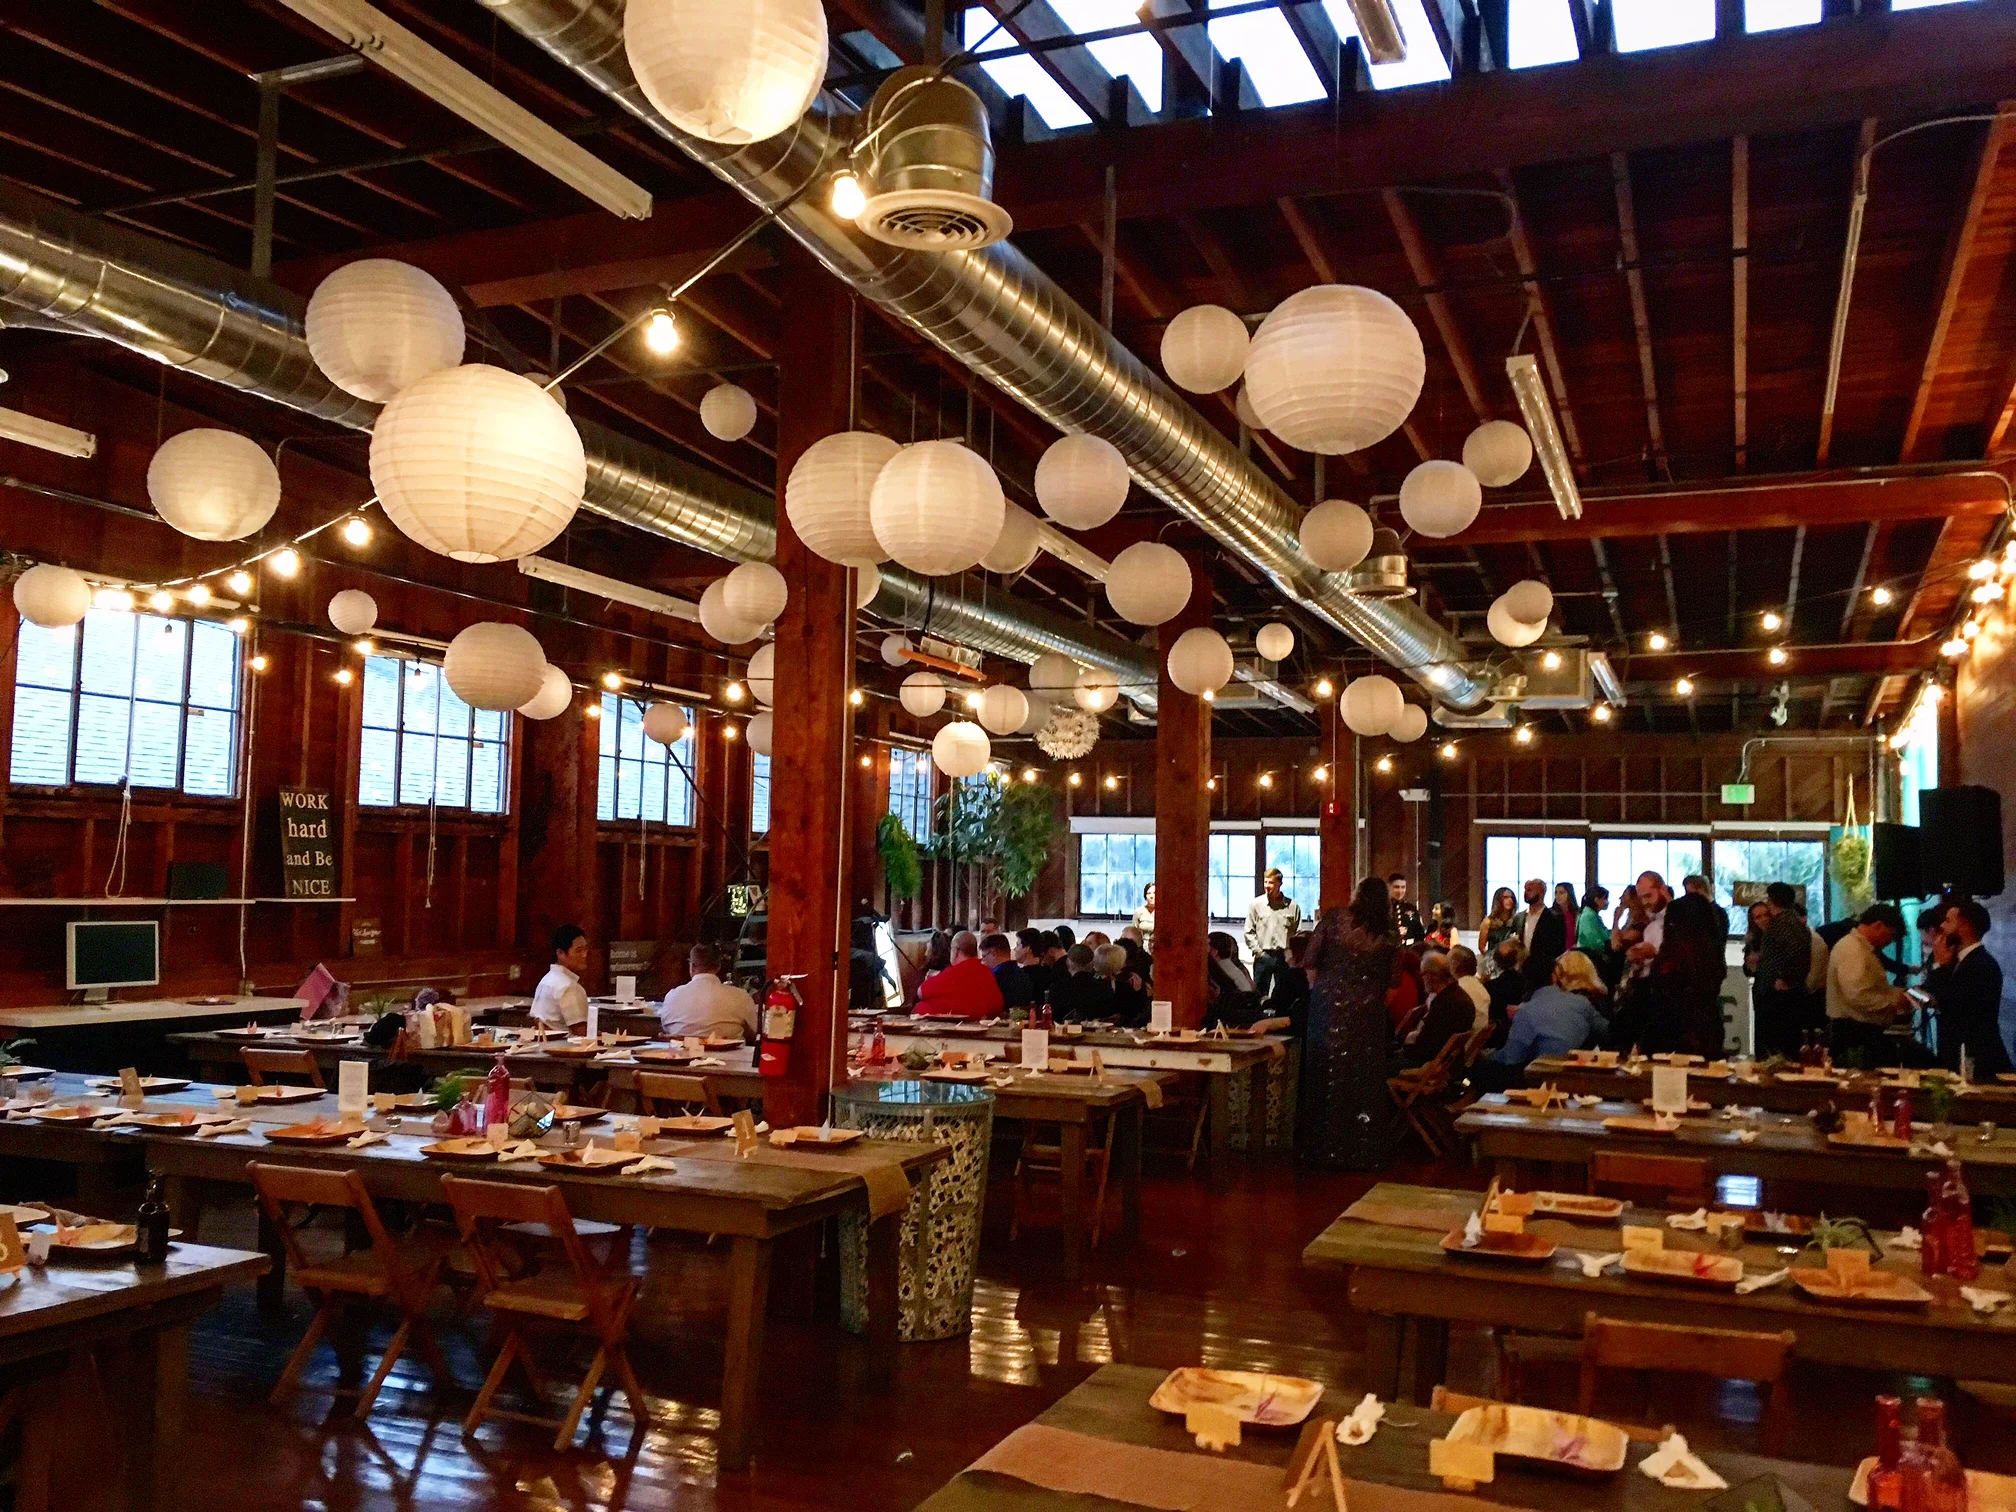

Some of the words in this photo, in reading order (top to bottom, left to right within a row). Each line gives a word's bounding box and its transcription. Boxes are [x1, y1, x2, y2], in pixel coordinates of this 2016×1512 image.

[280, 792, 328, 809] WORK
[287, 817, 328, 838] hard
[286, 850, 310, 866] and
[315, 850, 333, 866] Be
[292, 879, 330, 894] NICE
